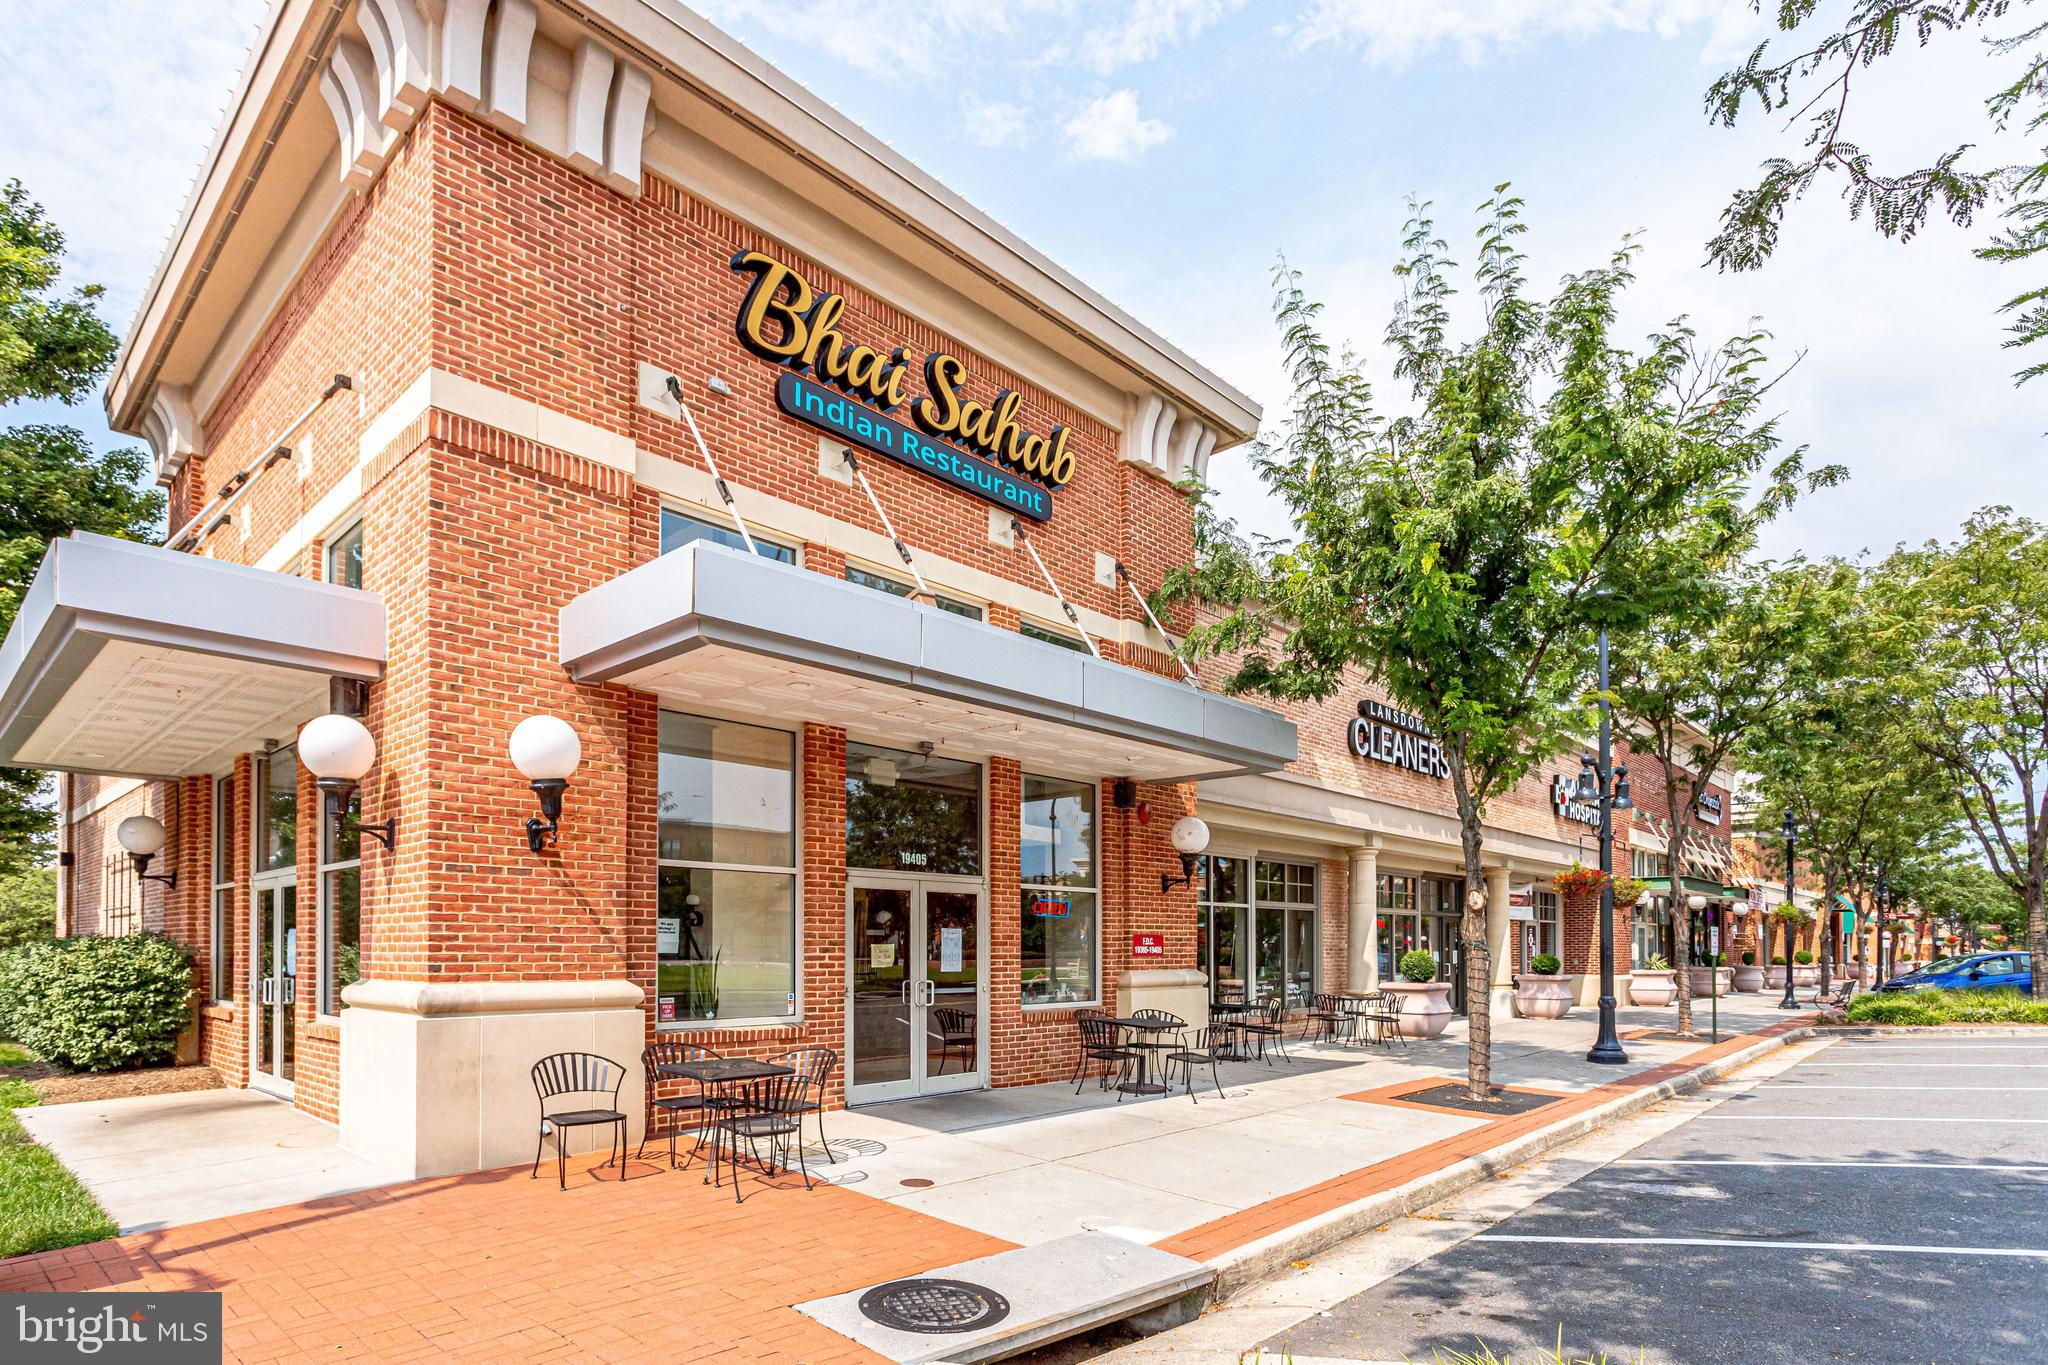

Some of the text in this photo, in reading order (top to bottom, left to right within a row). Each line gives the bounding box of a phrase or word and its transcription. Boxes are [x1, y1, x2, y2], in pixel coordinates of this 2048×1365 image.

[731, 249, 1076, 489] Bhai Sahab
[794, 381, 1043, 513] Indian Restaurant
[1352, 718, 1450, 779] CLEANERS
[1569, 801, 1600, 826] HOSPIT
[902, 852, 927, 865] 19405
[1033, 901, 1067, 915] OPEN
